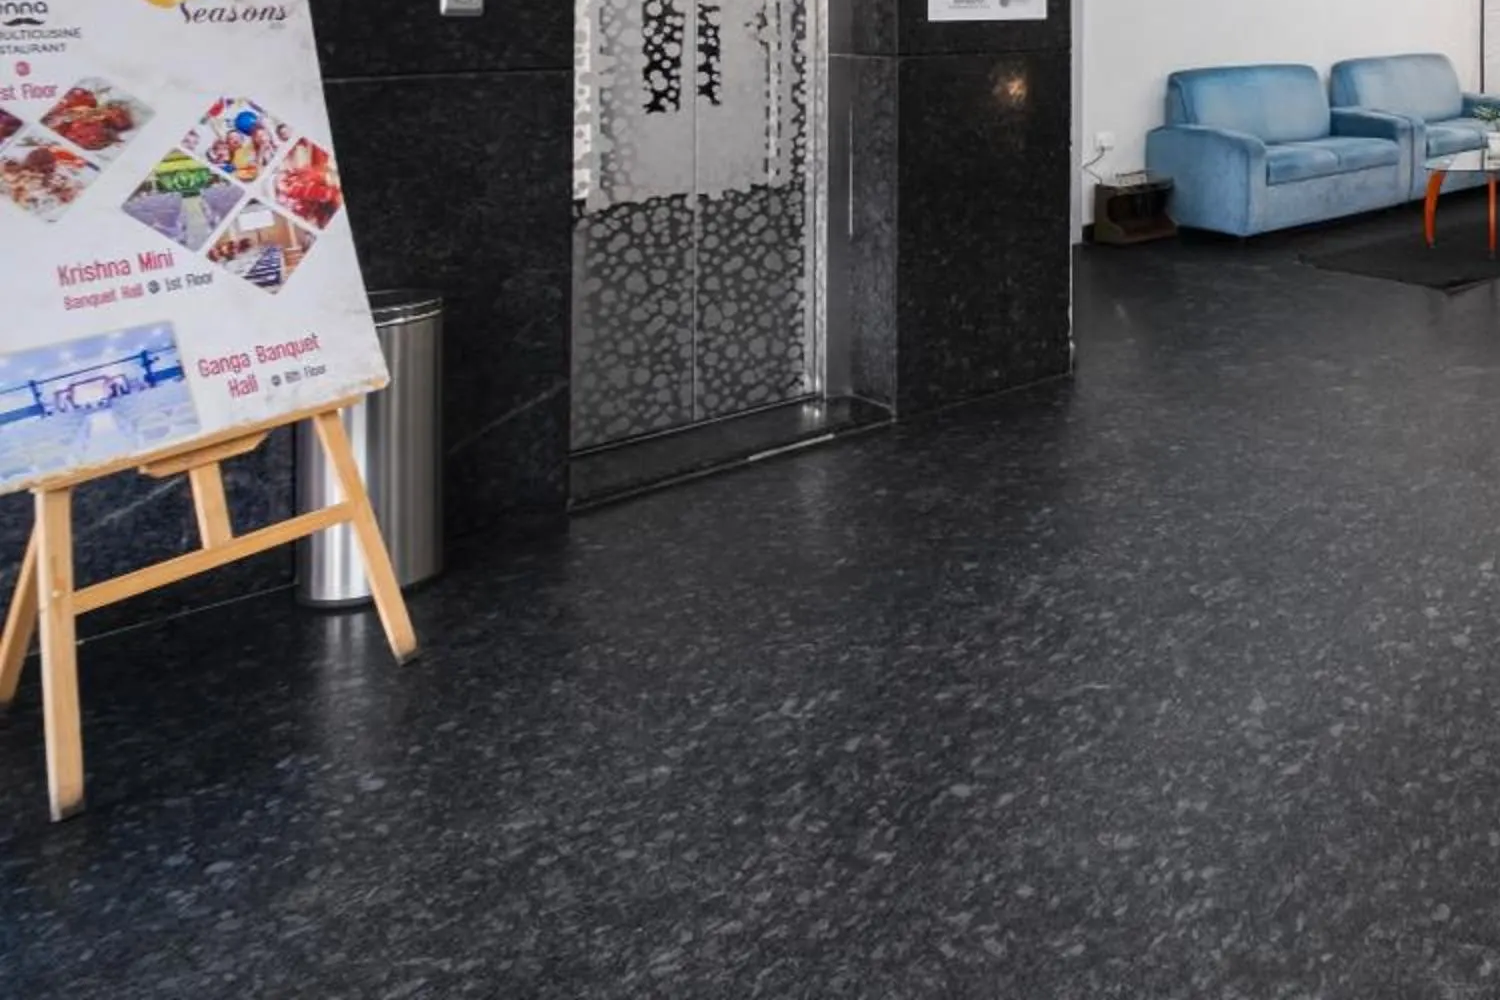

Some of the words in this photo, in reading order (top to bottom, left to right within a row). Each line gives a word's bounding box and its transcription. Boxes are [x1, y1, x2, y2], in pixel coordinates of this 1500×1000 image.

[179, 0, 288, 24] Seasons
[21, 82, 58, 100] Floor
[56, 258, 131, 287] Krishna
[137, 249, 174, 273] Mini
[63, 288, 117, 311] Banquet
[185, 271, 214, 288] Floor
[197, 352, 251, 378] Ganga
[254, 331, 320, 364] Banquet
[226, 373, 259, 398] Hall
